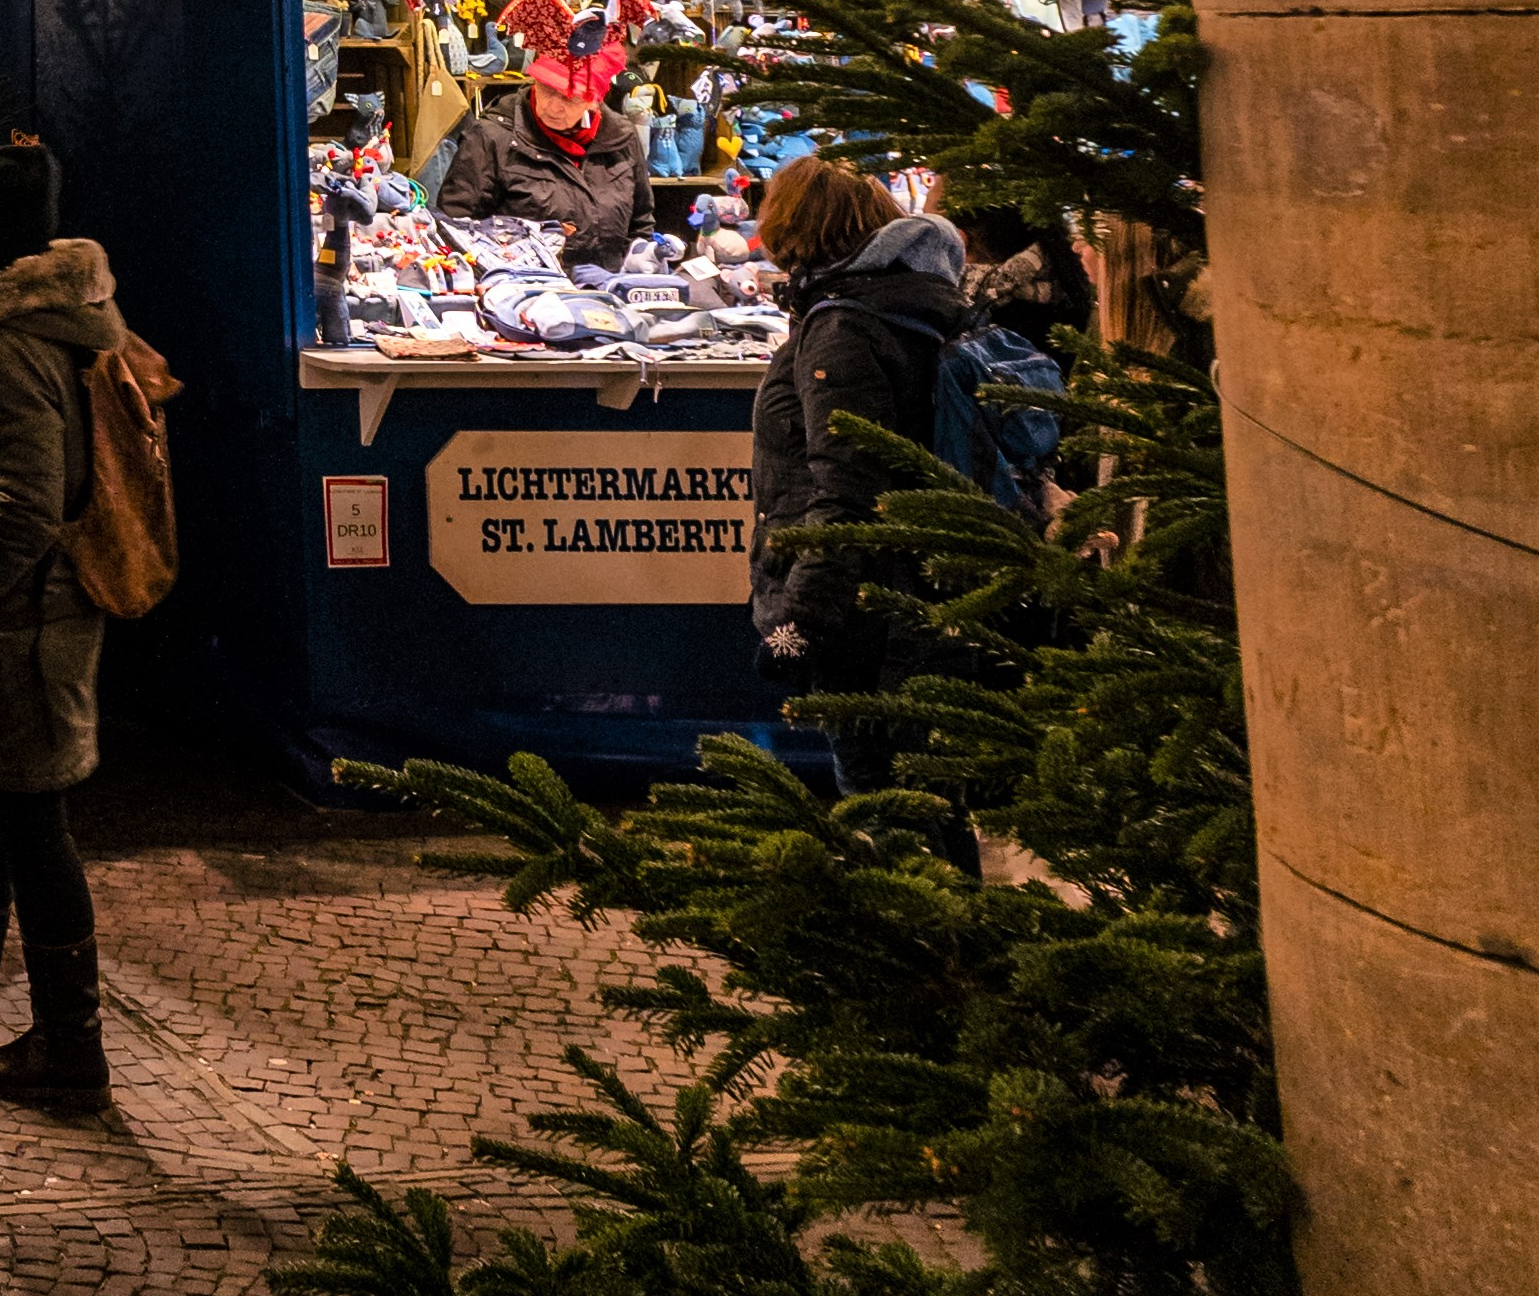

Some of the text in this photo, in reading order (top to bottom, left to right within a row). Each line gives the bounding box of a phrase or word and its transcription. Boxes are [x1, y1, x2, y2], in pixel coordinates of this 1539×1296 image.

[457, 466, 753, 502] LICHTERMARKT
[350, 503, 362, 517] 5
[336, 524, 378, 538] DR10
[481, 517, 747, 553] ST. LAMBERTI
